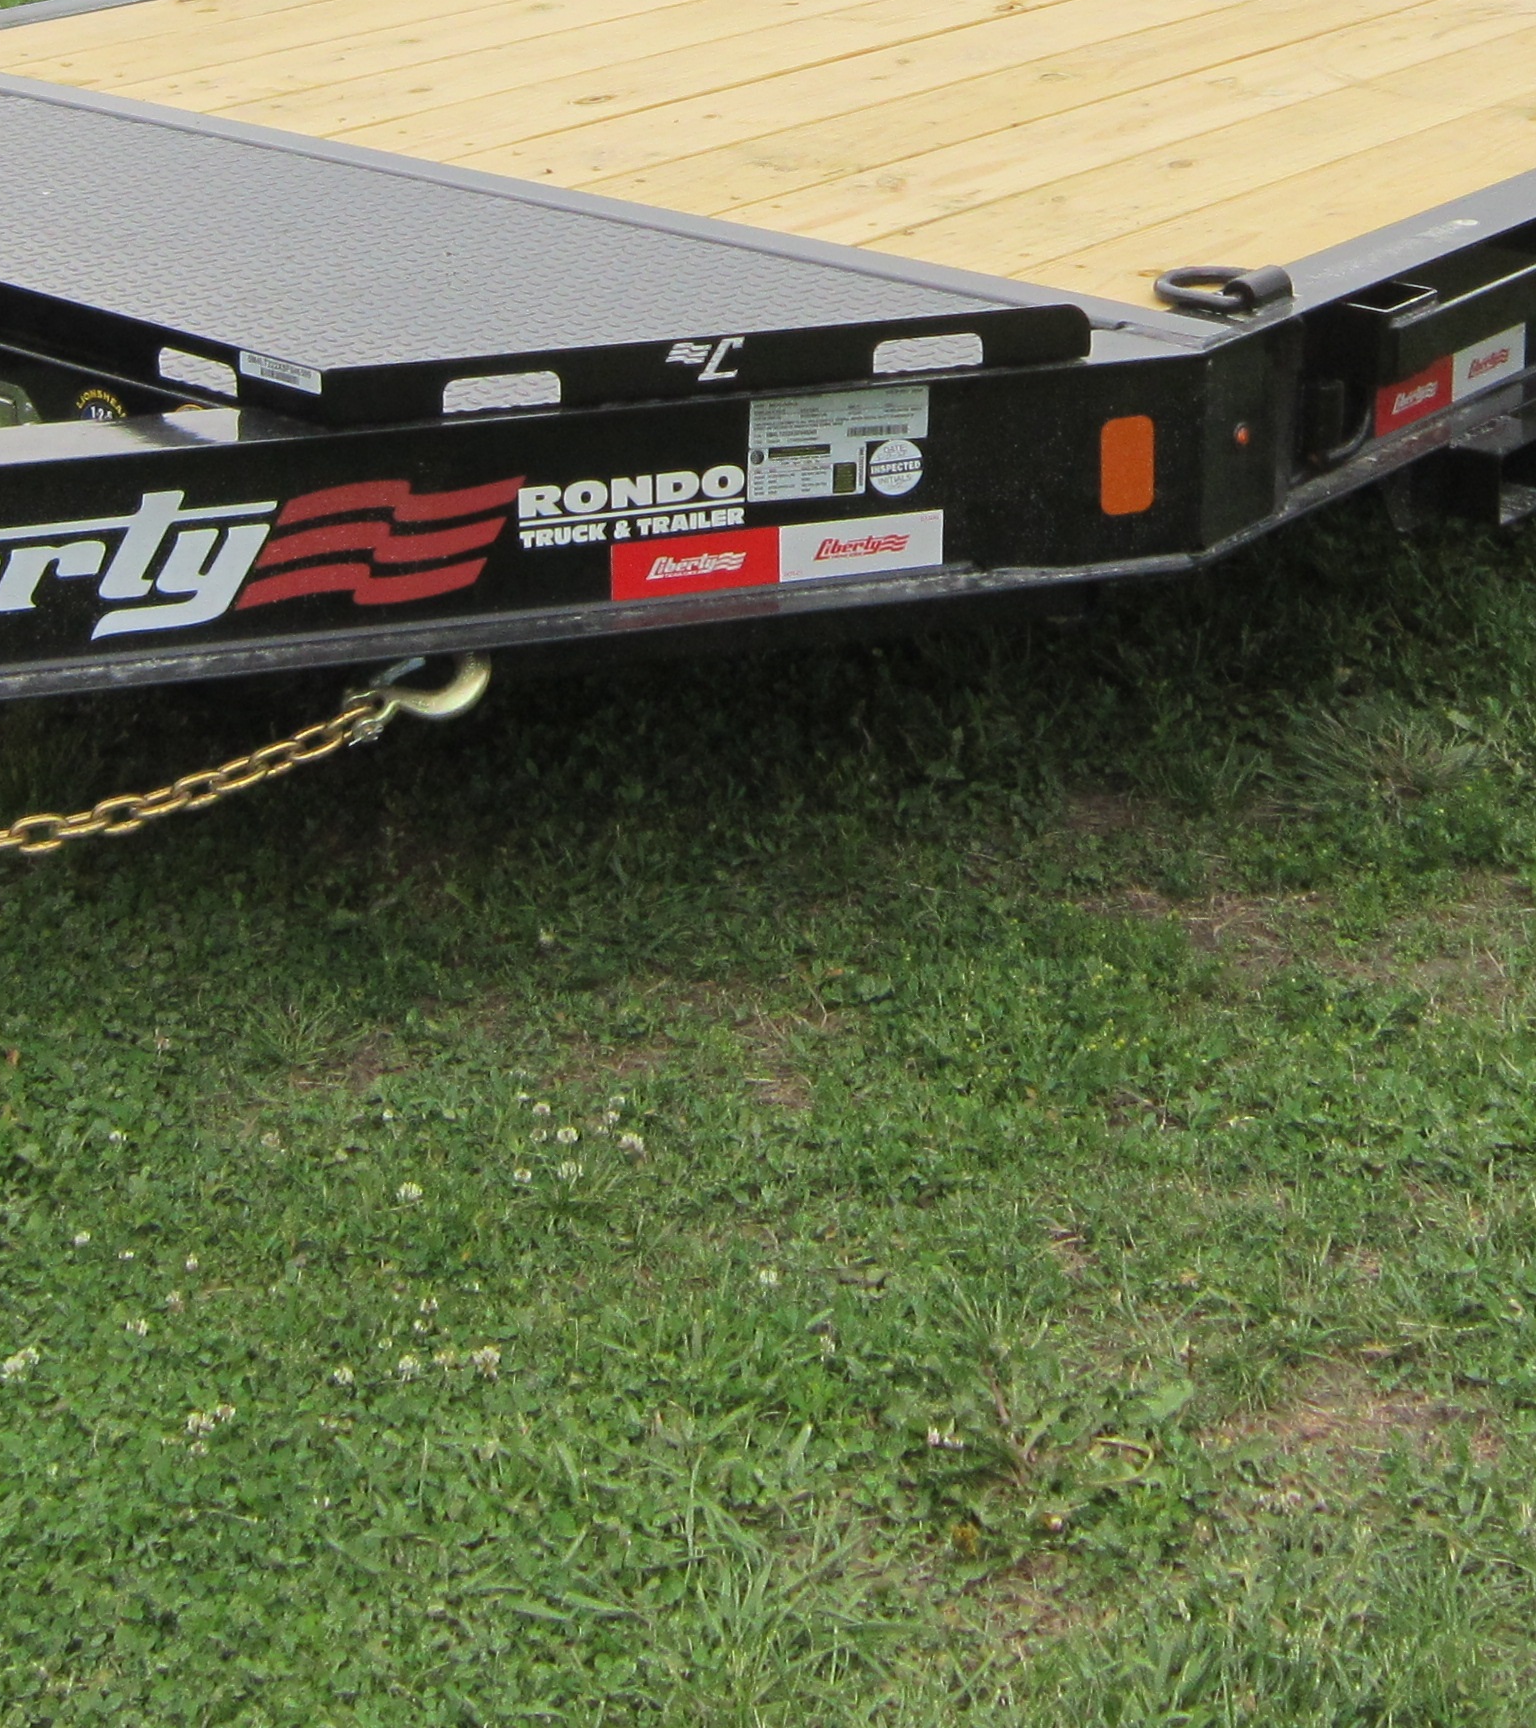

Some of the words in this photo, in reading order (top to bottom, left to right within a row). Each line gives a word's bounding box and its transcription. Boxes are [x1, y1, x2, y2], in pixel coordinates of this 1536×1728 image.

[870, 460, 922, 475] INSPECTED
[518, 465, 746, 518] RONDO
[519, 522, 607, 549] TRUCK
[613, 519, 632, 540] &
[636, 507, 745, 537] TRAILER
[814, 534, 885, 561] Liberty
[645, 552, 720, 581] Liberty
